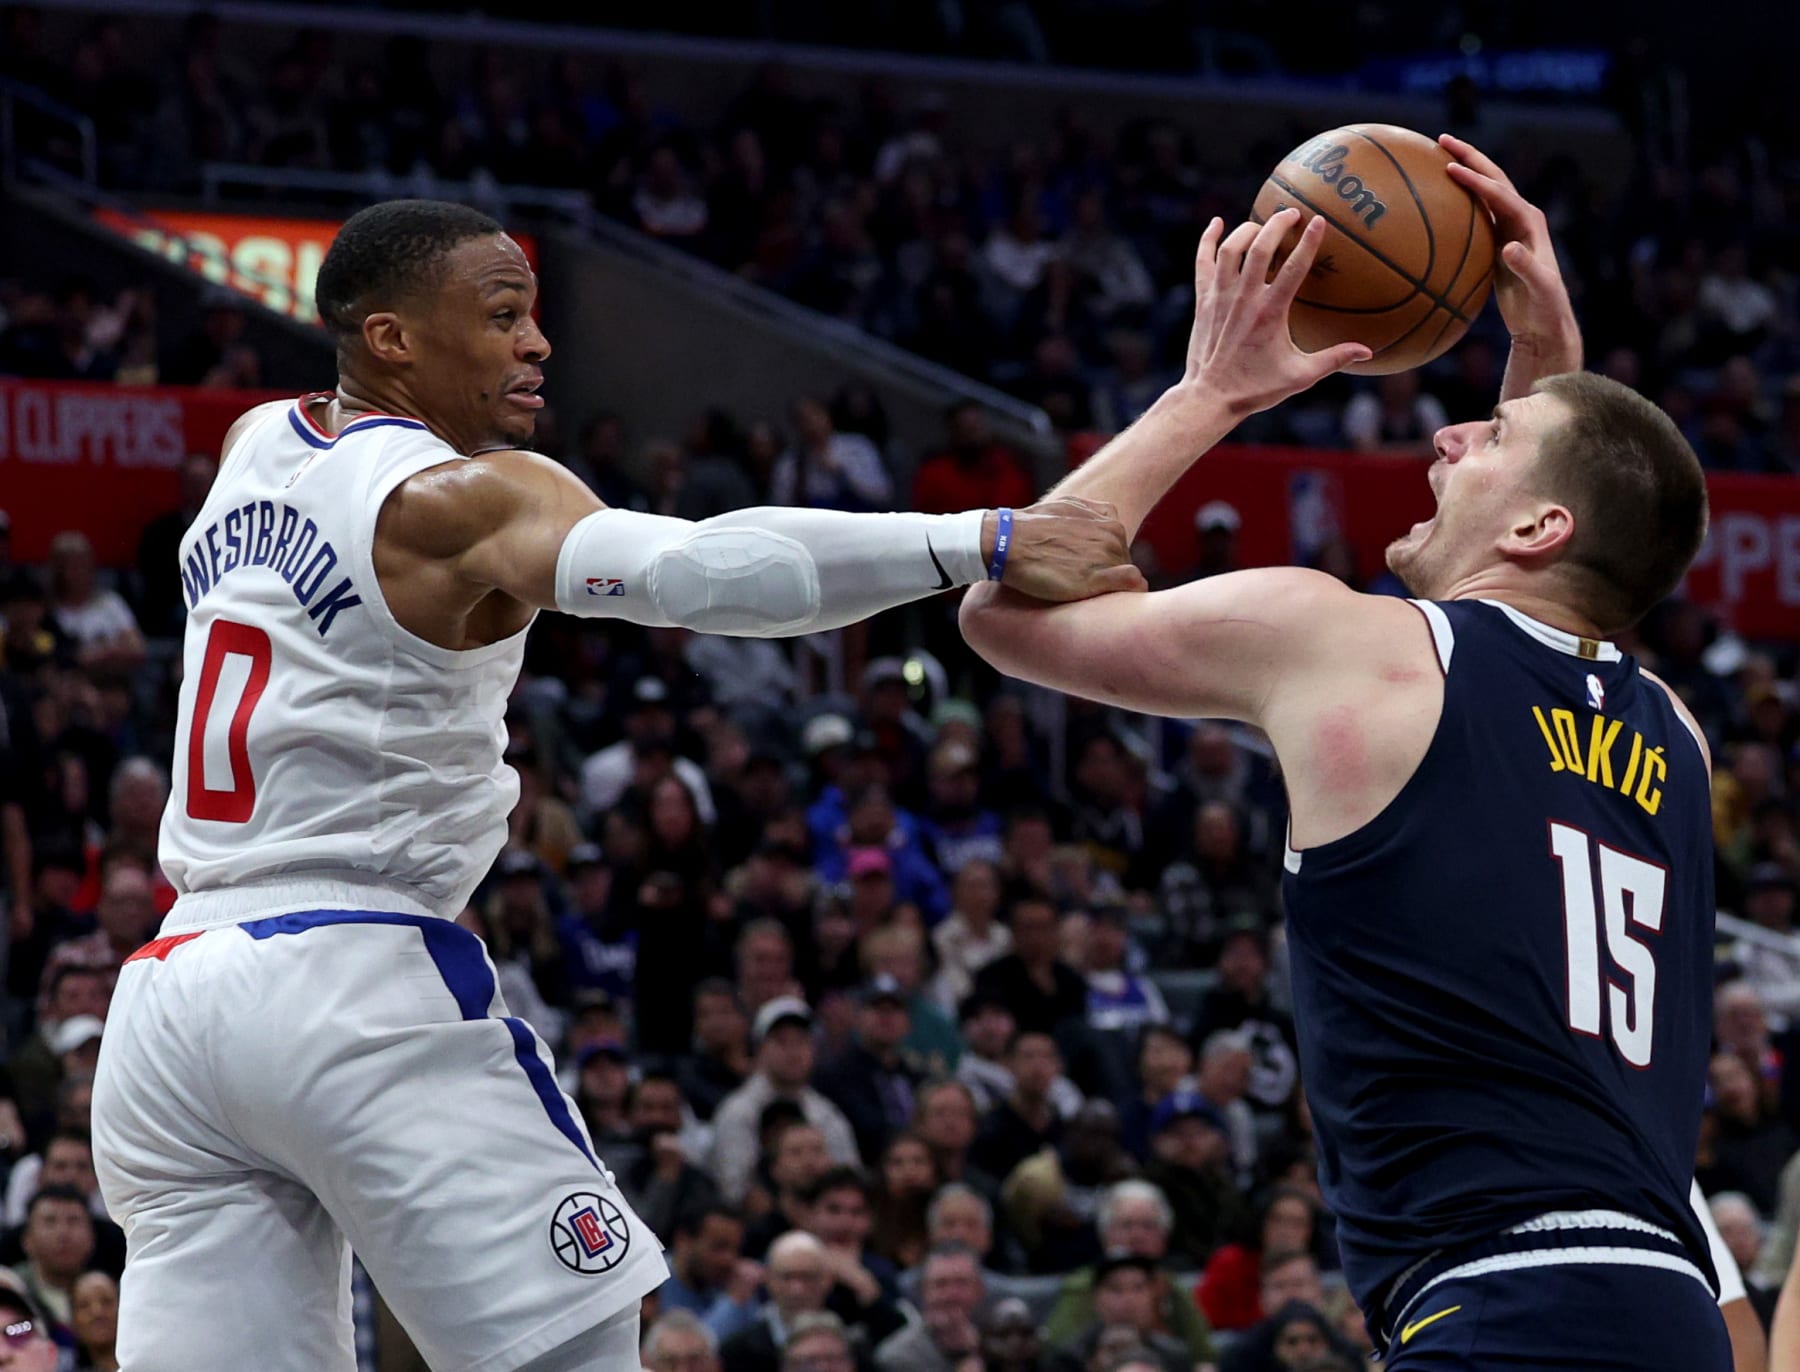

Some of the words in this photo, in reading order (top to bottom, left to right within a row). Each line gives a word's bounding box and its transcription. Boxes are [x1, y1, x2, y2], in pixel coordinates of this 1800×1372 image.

[17, 387, 185, 467] CLIPPERS
[182, 500, 362, 637] WESTBROOK
[186, 618, 272, 823] 0
[1532, 705, 1667, 816] JOKIĆ
[1547, 818, 1670, 1070] 15
